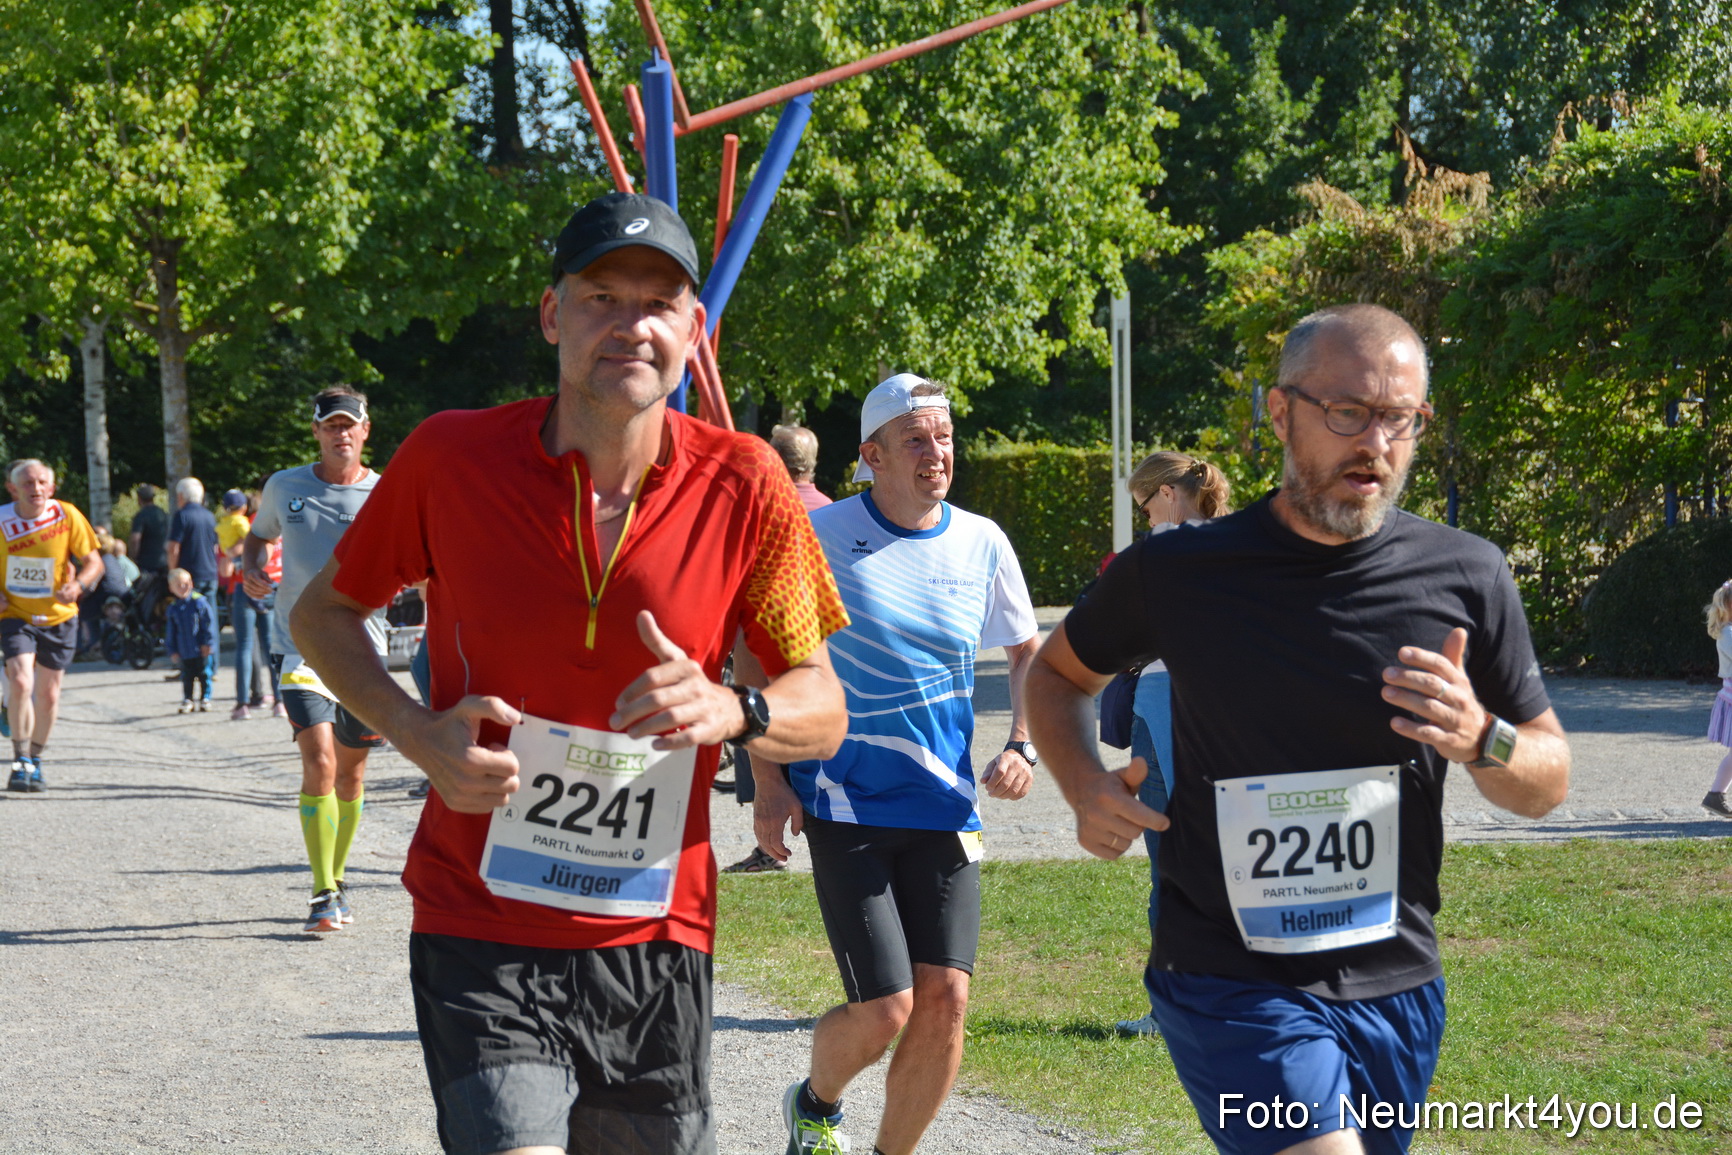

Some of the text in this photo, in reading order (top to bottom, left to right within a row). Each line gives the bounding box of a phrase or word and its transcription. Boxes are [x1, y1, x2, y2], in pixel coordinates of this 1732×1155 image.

[8, 538, 37, 553] MAX
[13, 567, 47, 581] 2423
[928, 578, 958, 586] SKI-CLUB
[567, 744, 647, 771] BOCK
[524, 773, 655, 840] 2241
[1268, 787, 1351, 811] BOCK
[505, 809, 513, 818] A
[532, 835, 629, 860] PARTL Neumarkt
[1247, 819, 1375, 880] 2240
[542, 863, 621, 896] Jürgen
[1234, 870, 1241, 880] C
[1263, 882, 1354, 899] PARTL Neumarkt
[1281, 905, 1354, 933] Helmut
